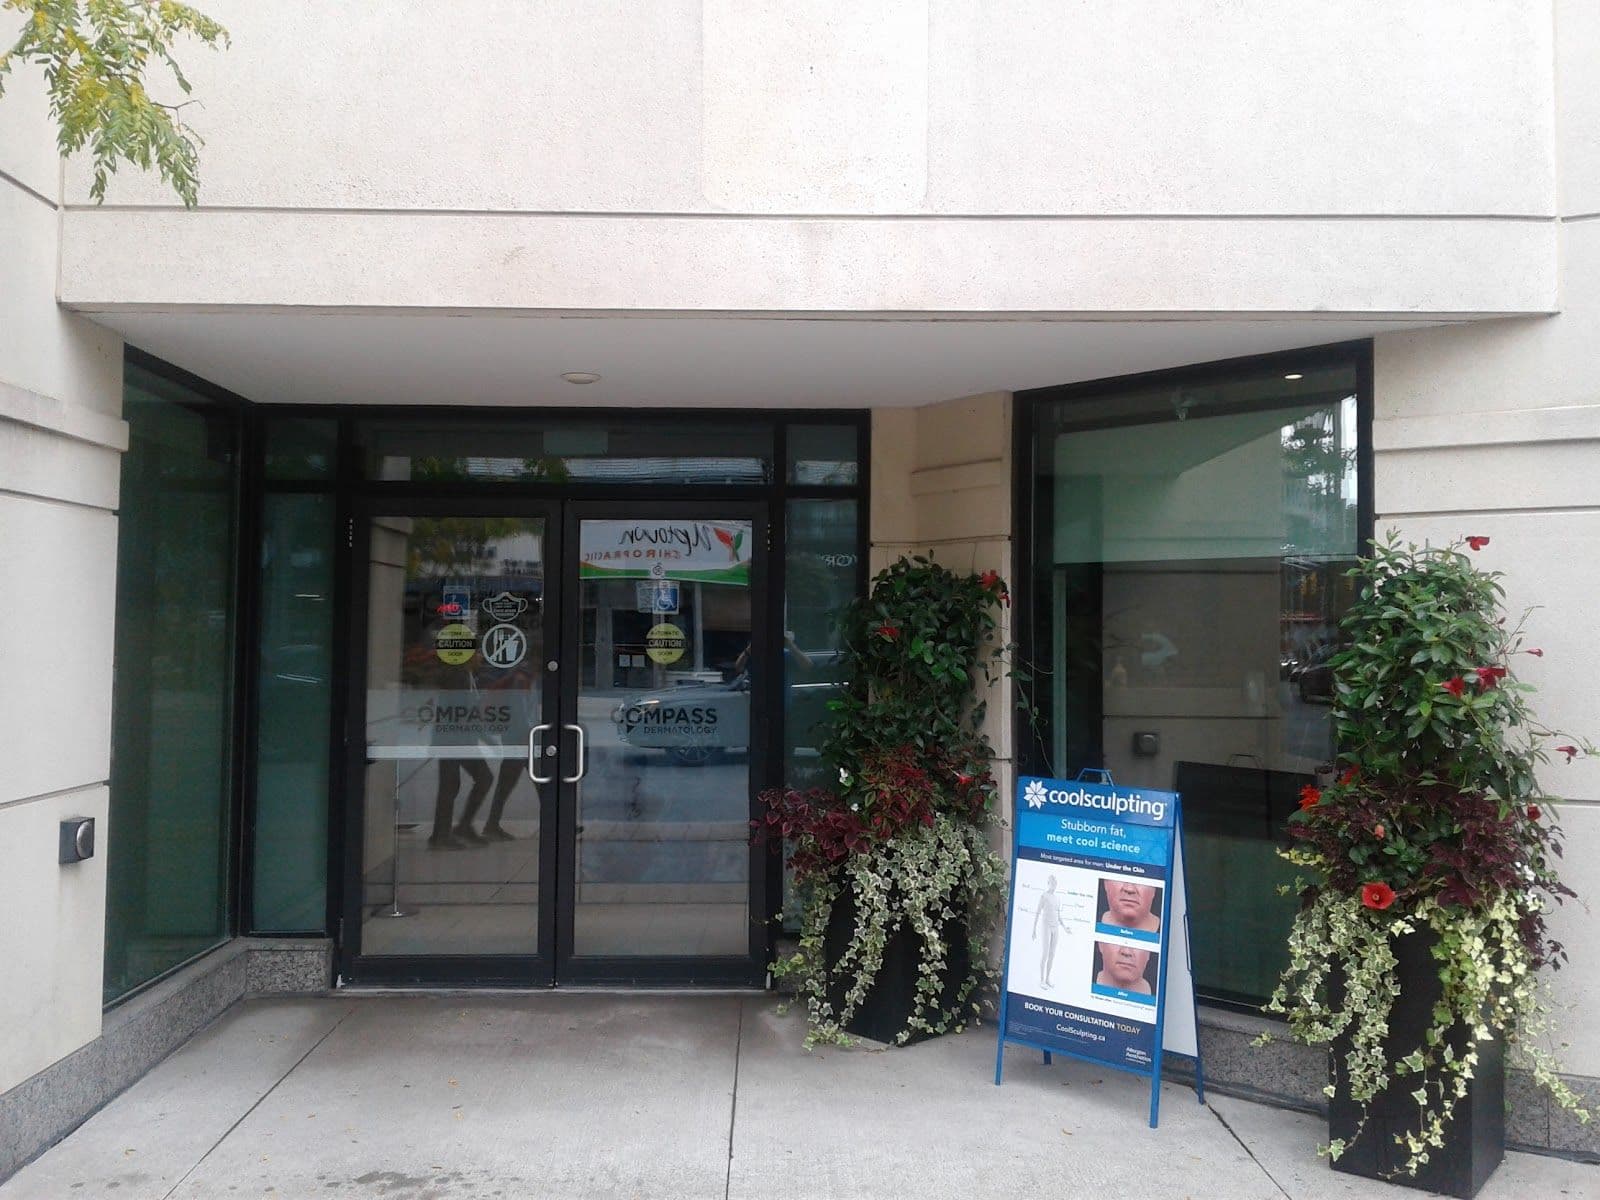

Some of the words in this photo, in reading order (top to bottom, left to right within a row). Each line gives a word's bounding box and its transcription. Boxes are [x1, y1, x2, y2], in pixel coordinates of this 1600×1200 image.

[438, 640, 473, 648] CAUTION
[648, 639, 682, 648] CAUTION
[404, 704, 512, 723] OMPASS
[643, 725, 718, 735] DERMATOLOGY
[1049, 788, 1165, 821] coolsculpting
[1060, 818, 1108, 835] Stubborn
[1109, 823, 1127, 839] fat,
[1046, 833, 1074, 845] meet
[1075, 836, 1099, 848] cool
[1101, 839, 1142, 854] science
[1105, 861, 1122, 871] Under
[1122, 864, 1132, 873] the
[1132, 866, 1145, 874] Chin
[1024, 1001, 1045, 1013] BOOK
[1044, 1006, 1064, 1019] YOUR
[1064, 1011, 1115, 1030] CONSULTATION
[1116, 1023, 1141, 1036] TODAY
[1055, 1023, 1106, 1042] CoolSculpting.ca
